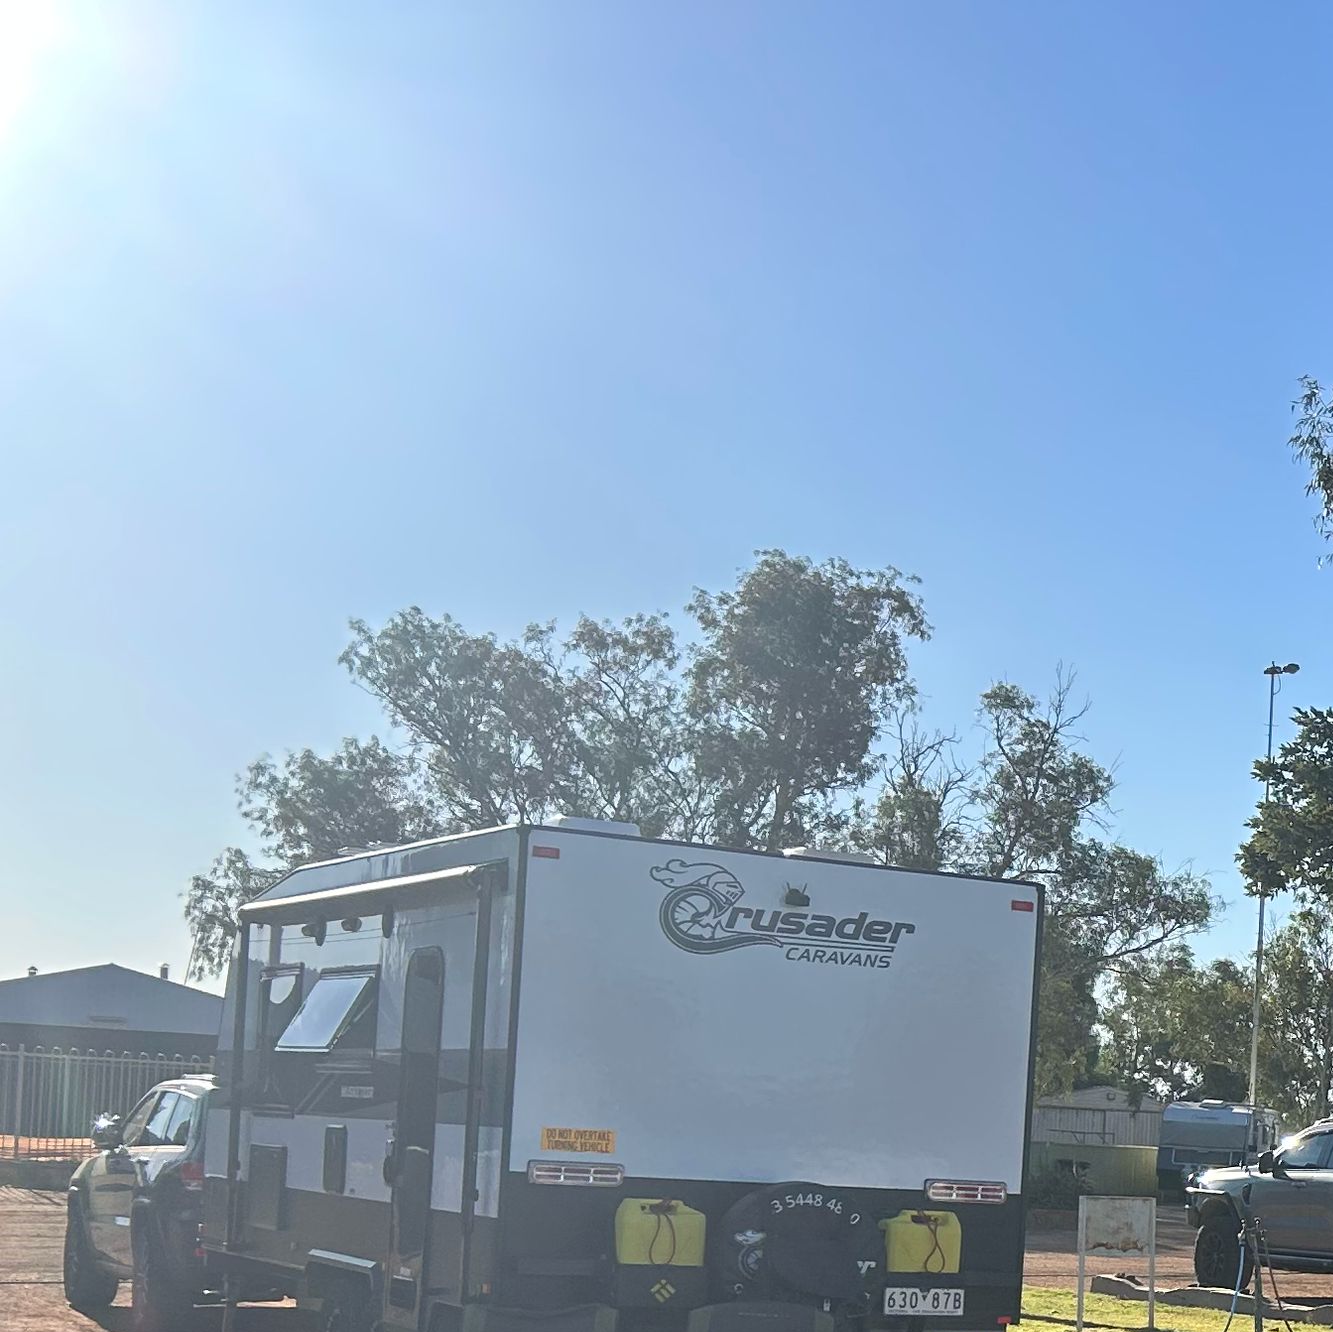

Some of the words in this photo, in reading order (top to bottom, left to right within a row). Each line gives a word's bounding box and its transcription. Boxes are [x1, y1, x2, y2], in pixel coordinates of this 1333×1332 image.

[785, 947, 893, 969] CARAVANS
[888, 1292, 918, 1309] 630
[932, 1292, 961, 1310] 87B
